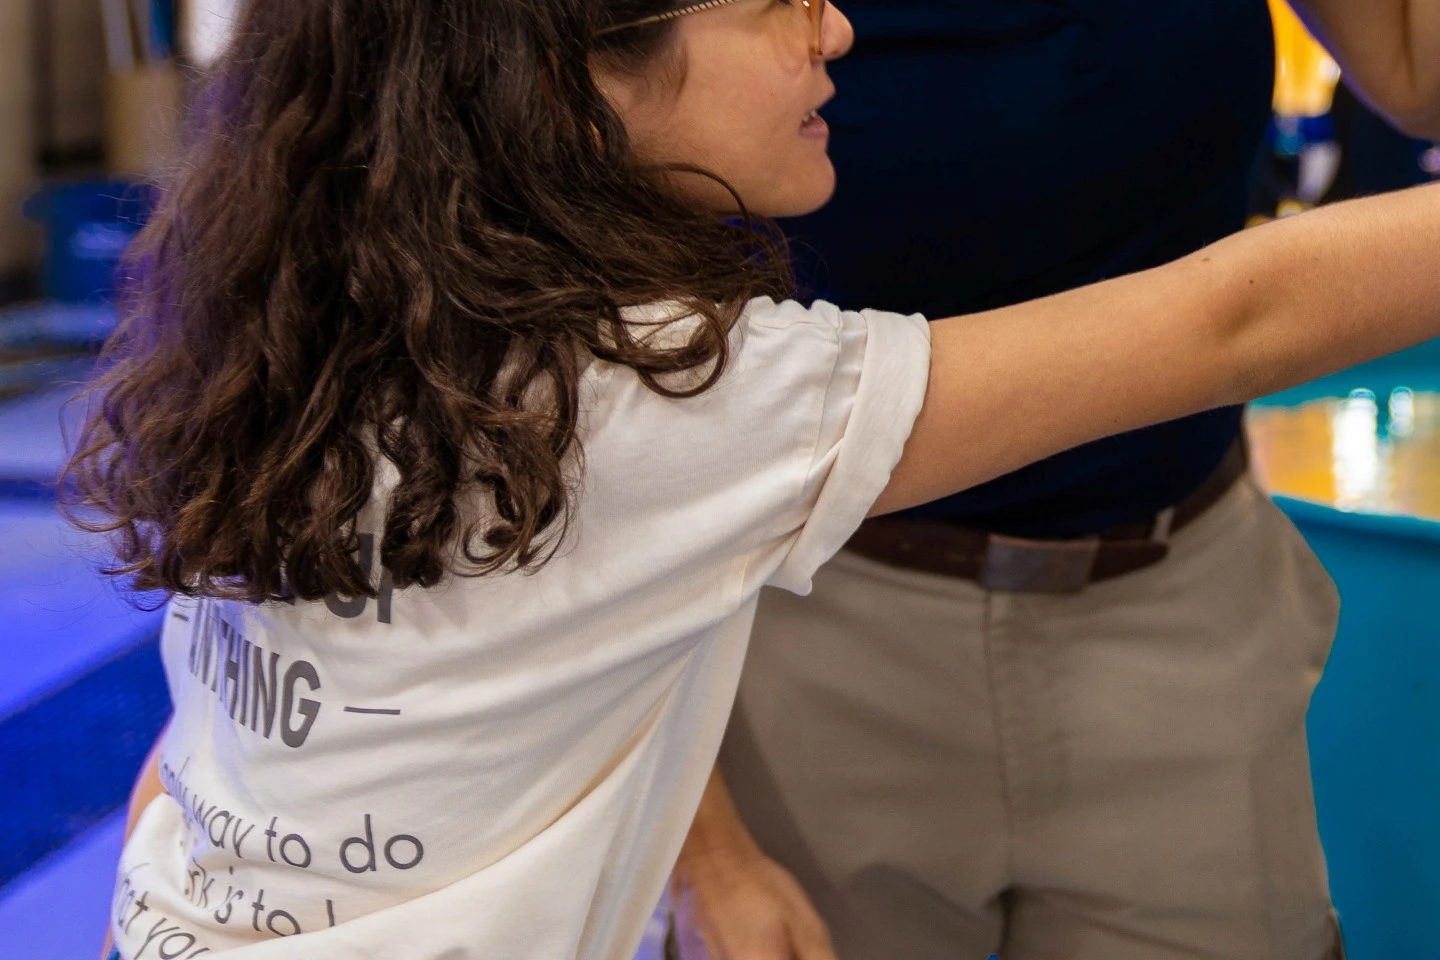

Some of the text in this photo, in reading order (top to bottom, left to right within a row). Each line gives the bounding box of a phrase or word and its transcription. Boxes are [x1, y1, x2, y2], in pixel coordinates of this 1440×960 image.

[265, 816, 312, 869] to
[340, 814, 424, 874] do
[252, 889, 301, 937] to
